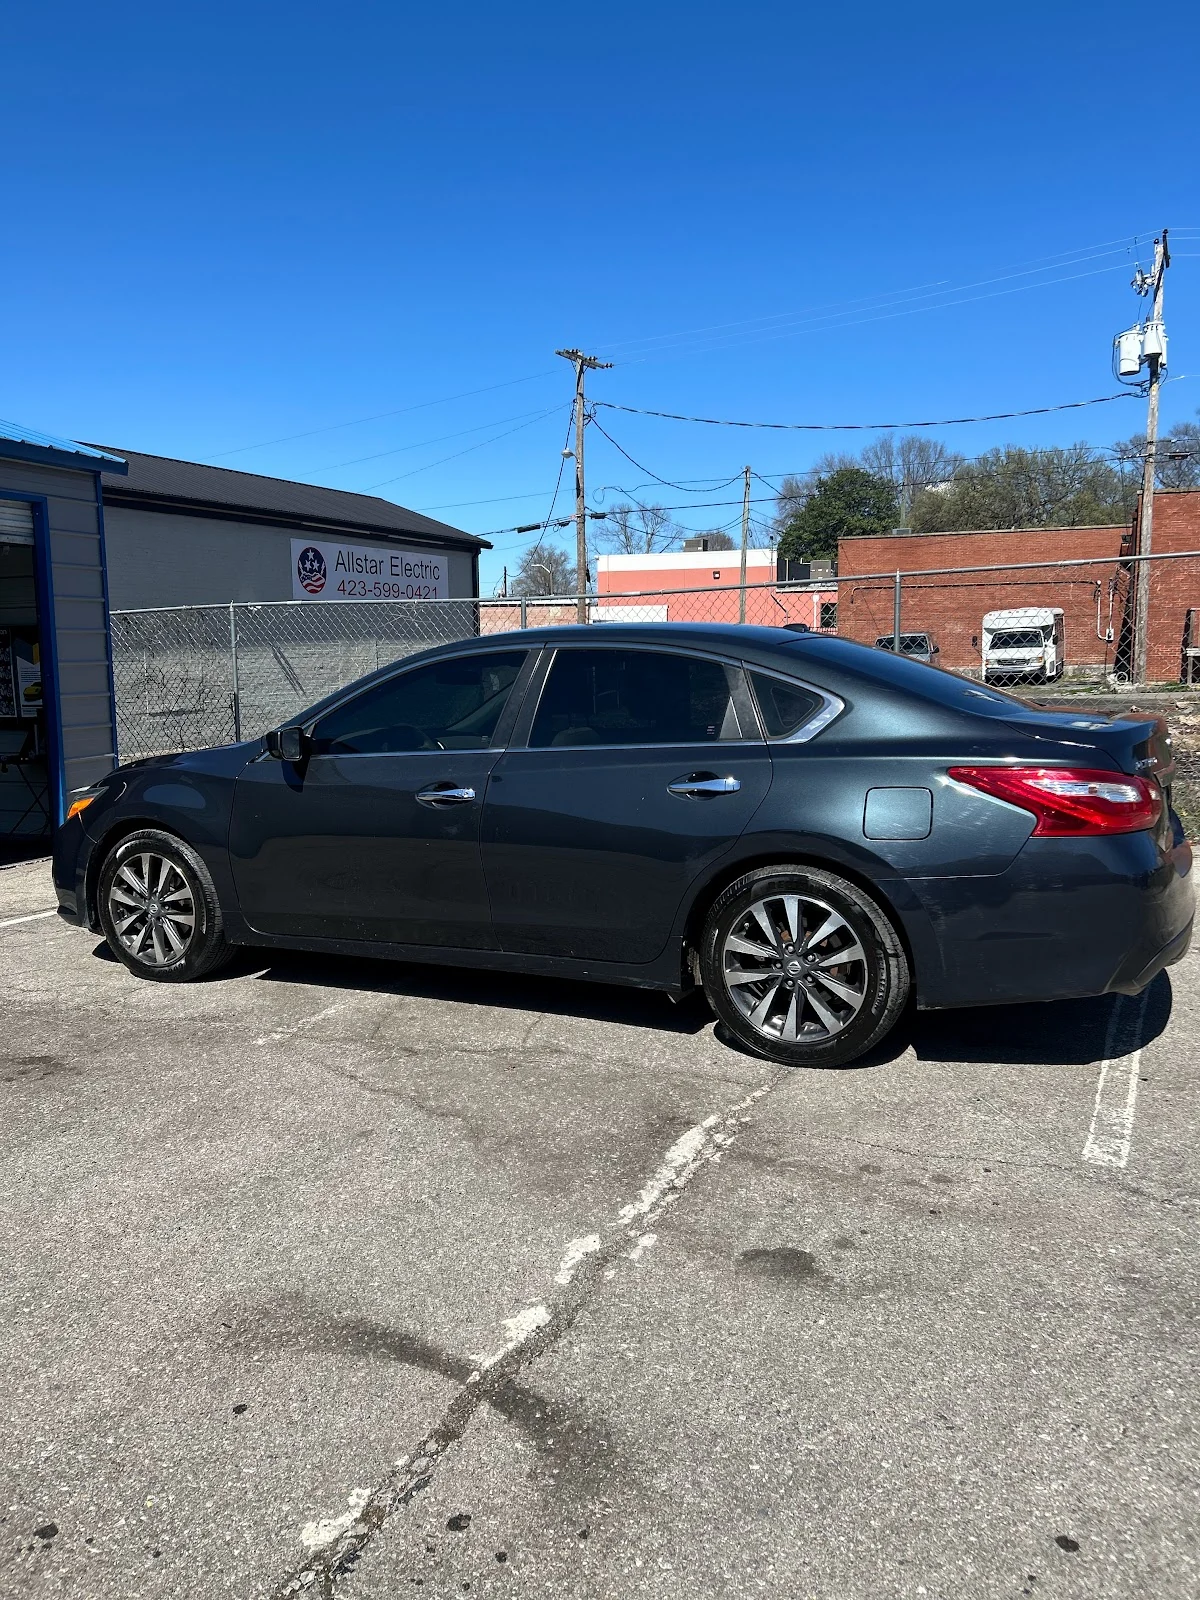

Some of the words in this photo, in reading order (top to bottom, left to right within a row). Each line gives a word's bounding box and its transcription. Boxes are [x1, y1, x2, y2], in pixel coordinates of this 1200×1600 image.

[335, 550, 384, 576] Allstar
[390, 556, 440, 581] Electric
[337, 579, 437, 600] 423-599-0421
